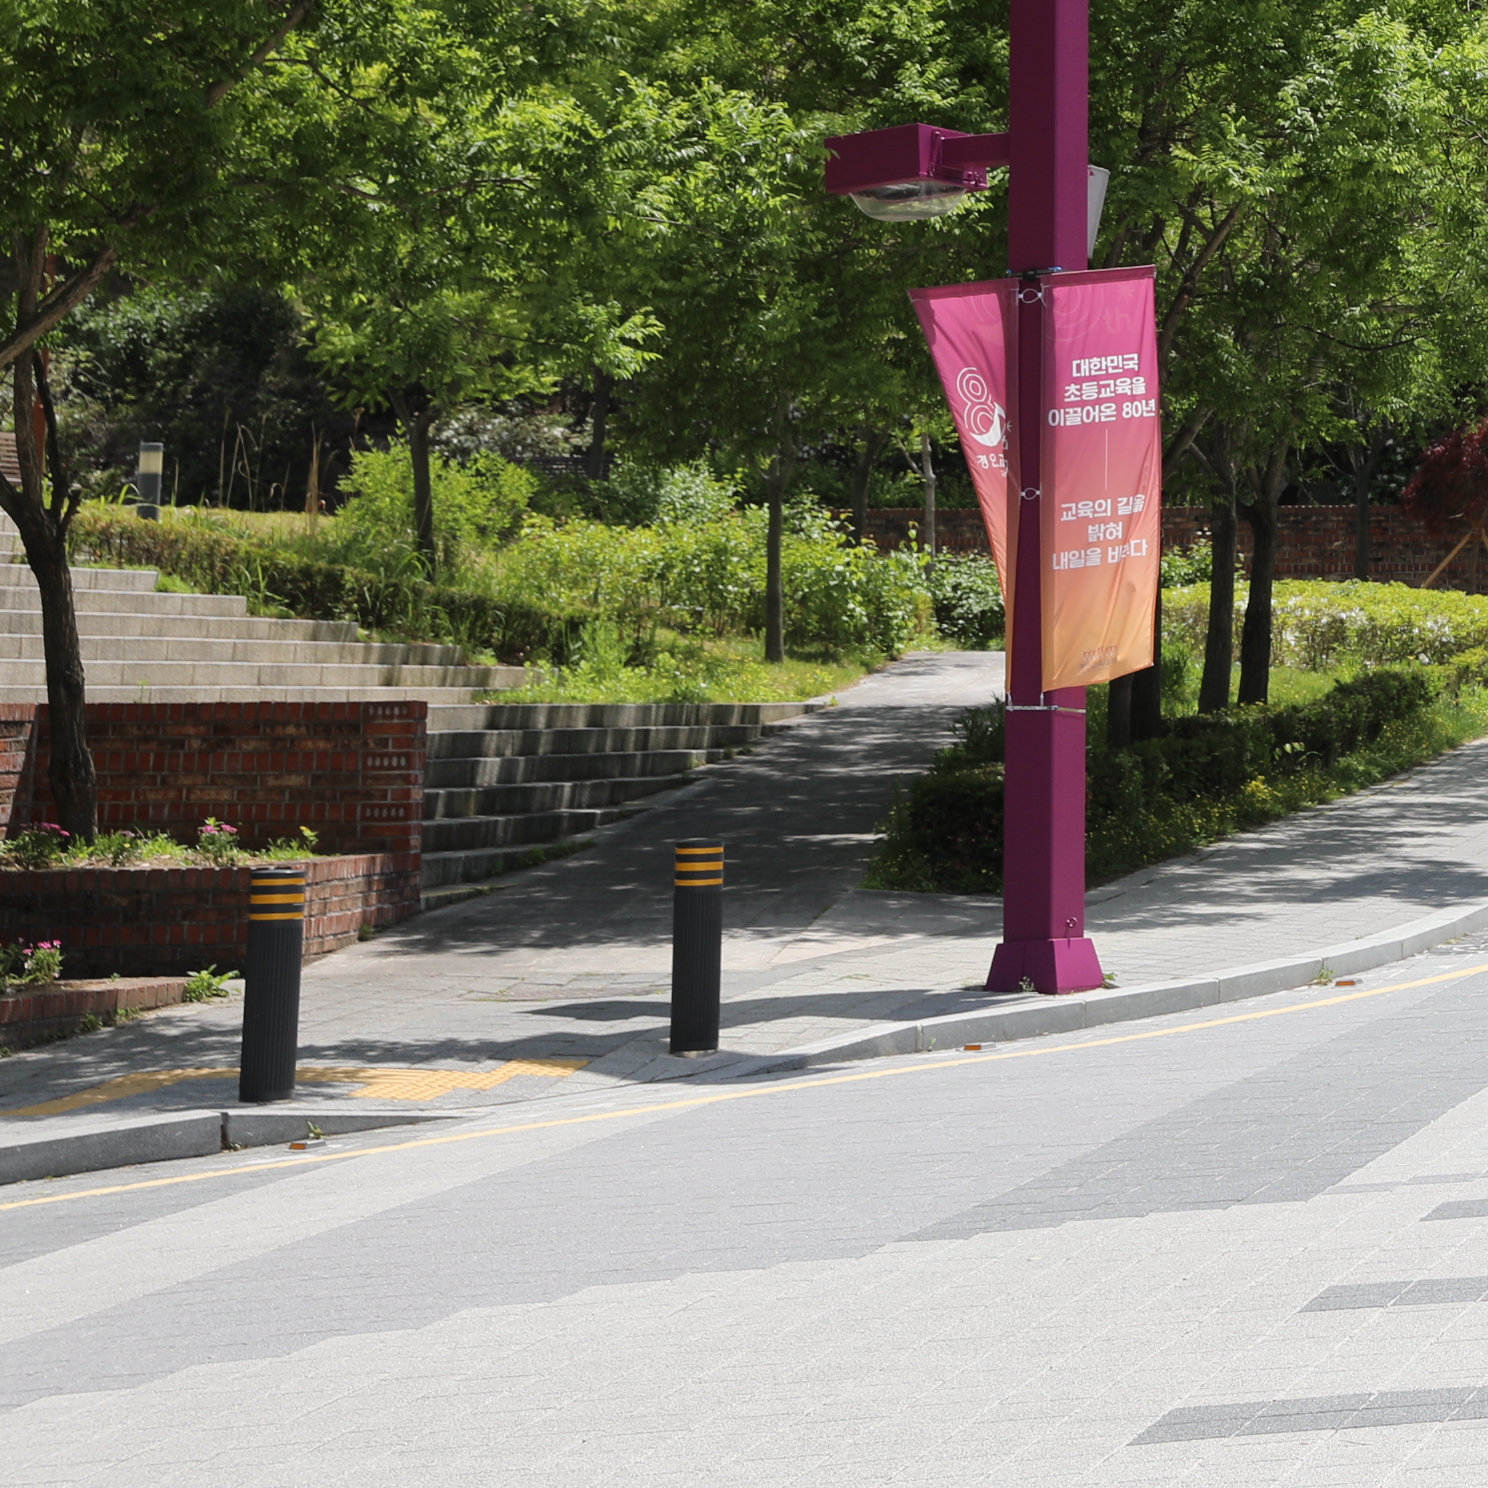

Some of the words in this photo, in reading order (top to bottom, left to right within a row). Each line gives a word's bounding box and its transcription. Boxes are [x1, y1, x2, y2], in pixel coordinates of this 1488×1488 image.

[1072, 353, 1139, 378] 대한민국
[1064, 376, 1146, 402] 초등교육을
[1048, 402, 1117, 426] 이끌어온
[1060, 498, 1112, 521] 교육의
[1117, 494, 1145, 515] 길을
[1088, 522, 1123, 542] 밝혀
[1052, 547, 1102, 570] 내일을
